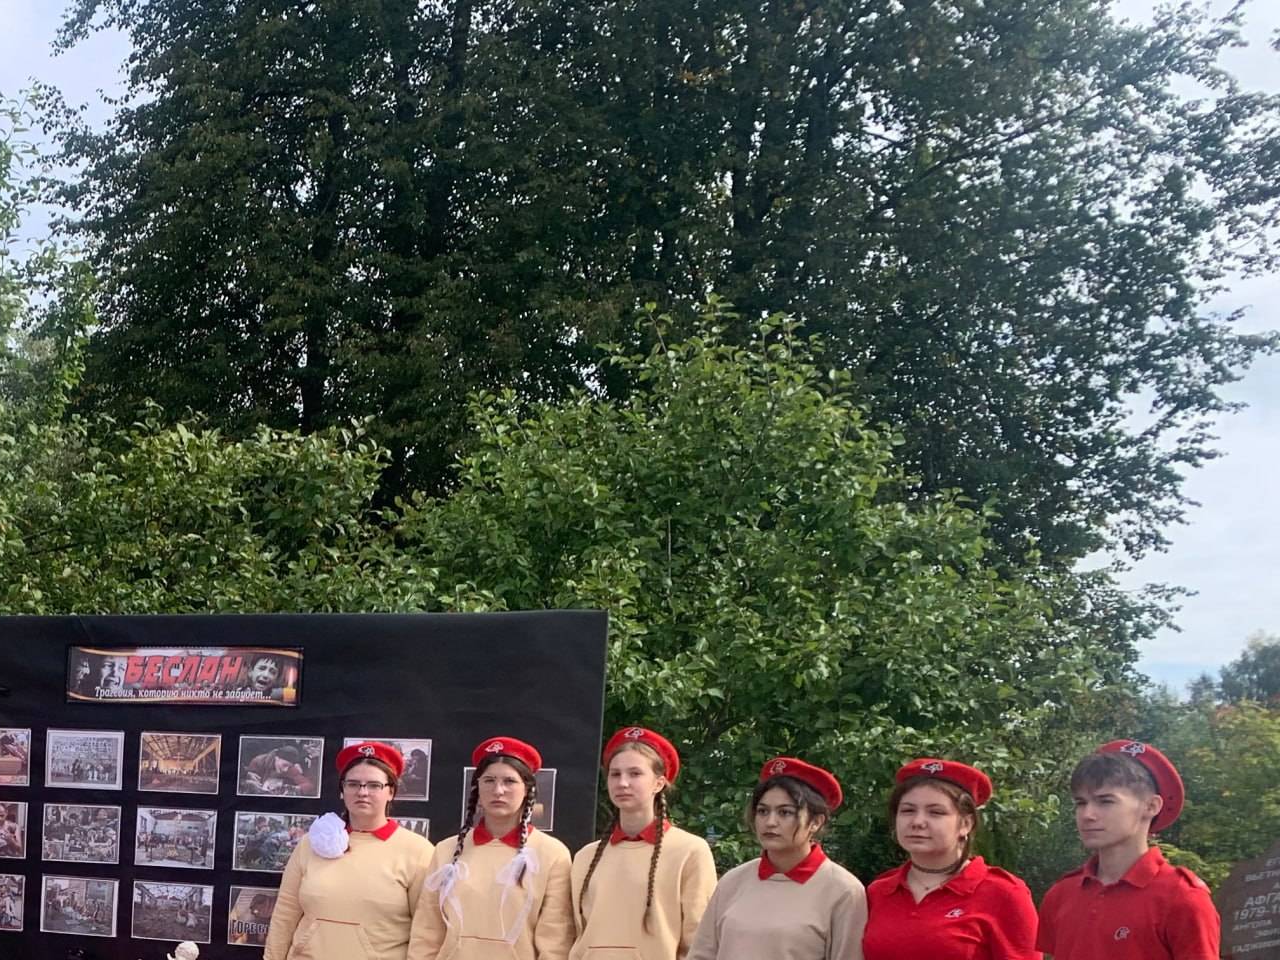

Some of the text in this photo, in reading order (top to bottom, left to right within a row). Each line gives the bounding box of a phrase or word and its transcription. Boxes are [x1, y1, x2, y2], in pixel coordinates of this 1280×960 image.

[124, 655, 243, 687] БЕСЛАН
[95, 685, 136, 699] Трагедия,
[181, 687, 210, 698] никто
[212, 688, 224, 698] не
[1233, 905, 1280, 921] 1979-1
